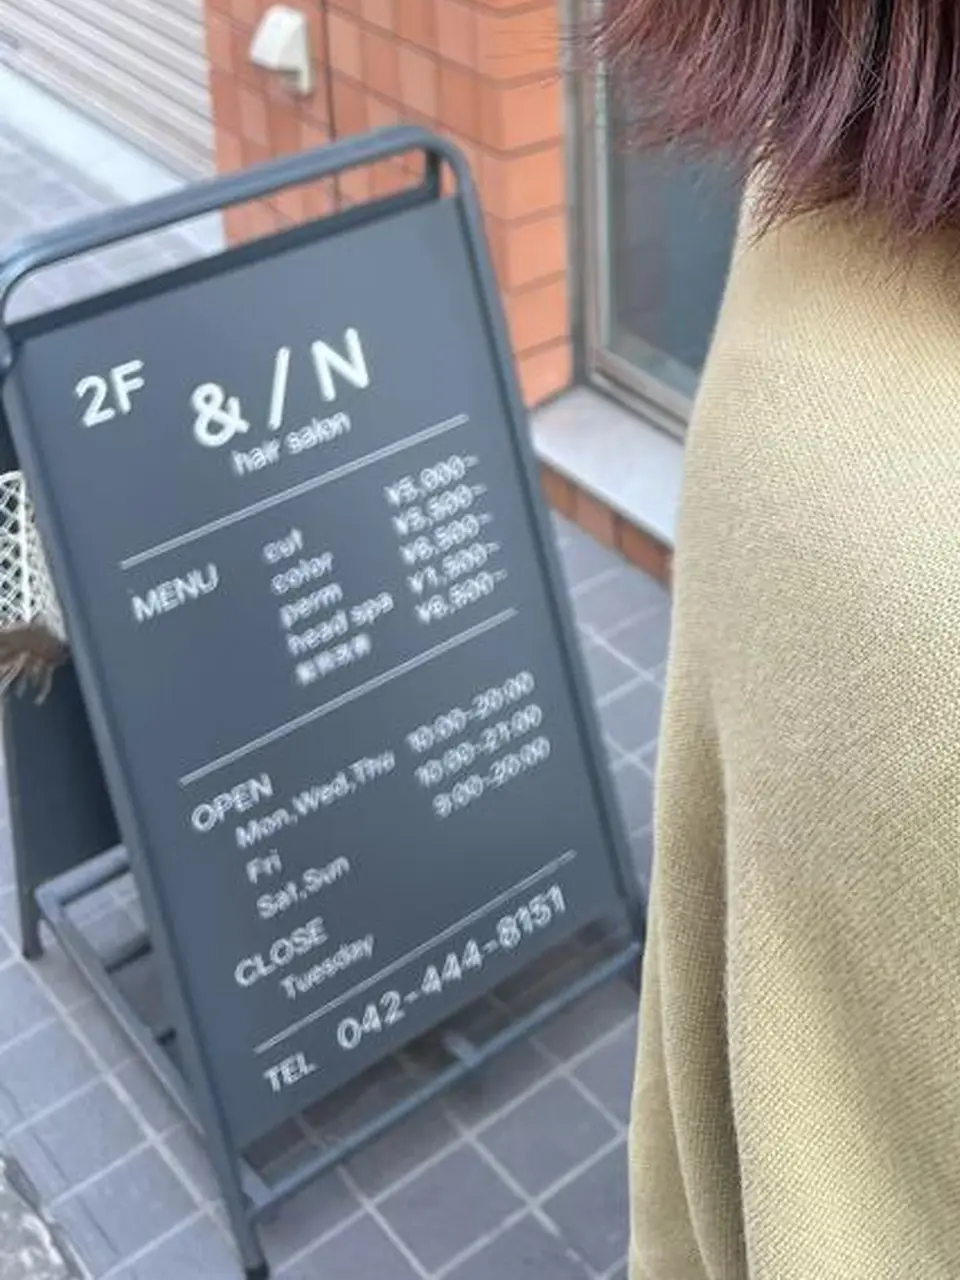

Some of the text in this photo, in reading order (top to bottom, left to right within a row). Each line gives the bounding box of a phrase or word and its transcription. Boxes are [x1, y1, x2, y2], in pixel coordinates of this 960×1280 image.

[75, 359, 144, 427] 2F
[231, 411, 351, 476] hair salon
[263, 528, 303, 563] cut
[271, 552, 333, 595] color
[132, 562, 219, 622] MENU
[279, 583, 343, 629] perm
[287, 592, 394, 656] head spa
[192, 773, 274, 832] OPEN
[247, 849, 282, 883] Fri
[234, 916, 329, 987] CLOSE
[280, 934, 374, 999] Tuesday
[264, 884, 565, 1092] TEL 042-444-8151
